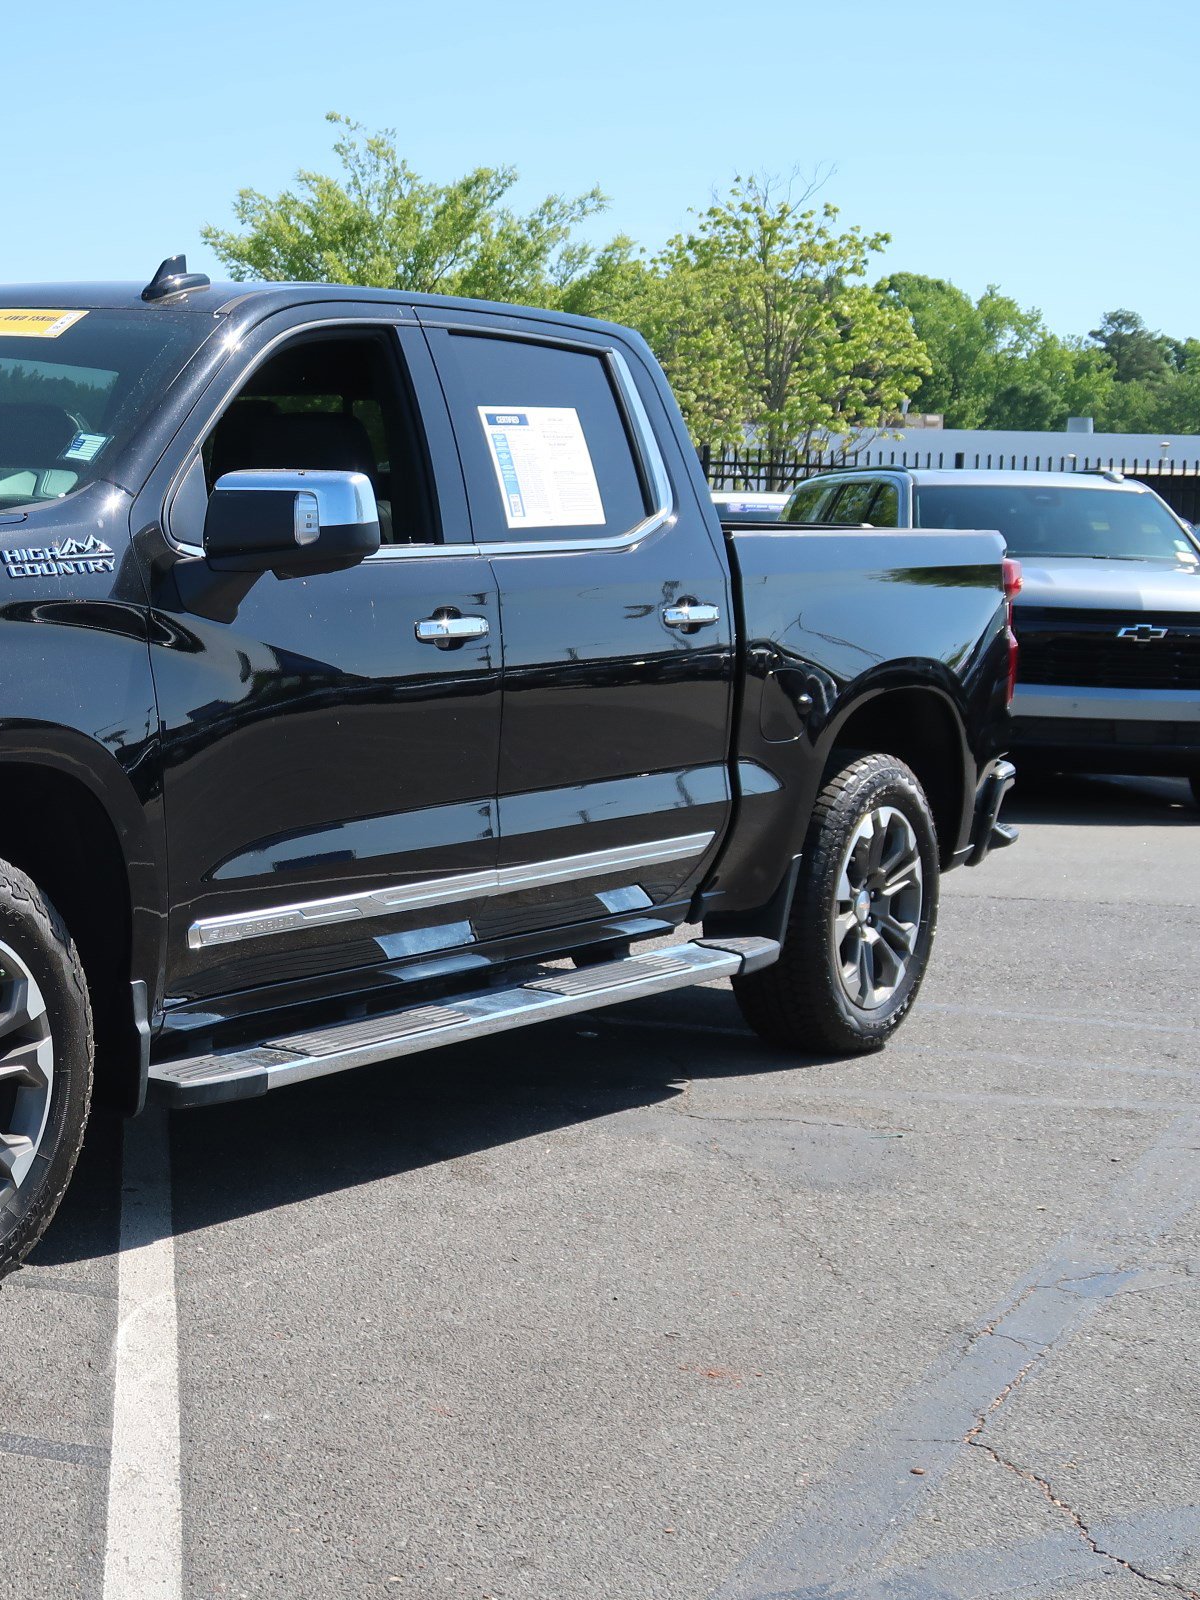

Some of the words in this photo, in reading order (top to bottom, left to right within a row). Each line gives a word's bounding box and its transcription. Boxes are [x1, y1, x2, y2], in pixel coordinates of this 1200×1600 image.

[0, 547, 61, 565] HIGH
[6, 558, 116, 579] COUNTRY
[209, 917, 297, 940] SILVERADO
